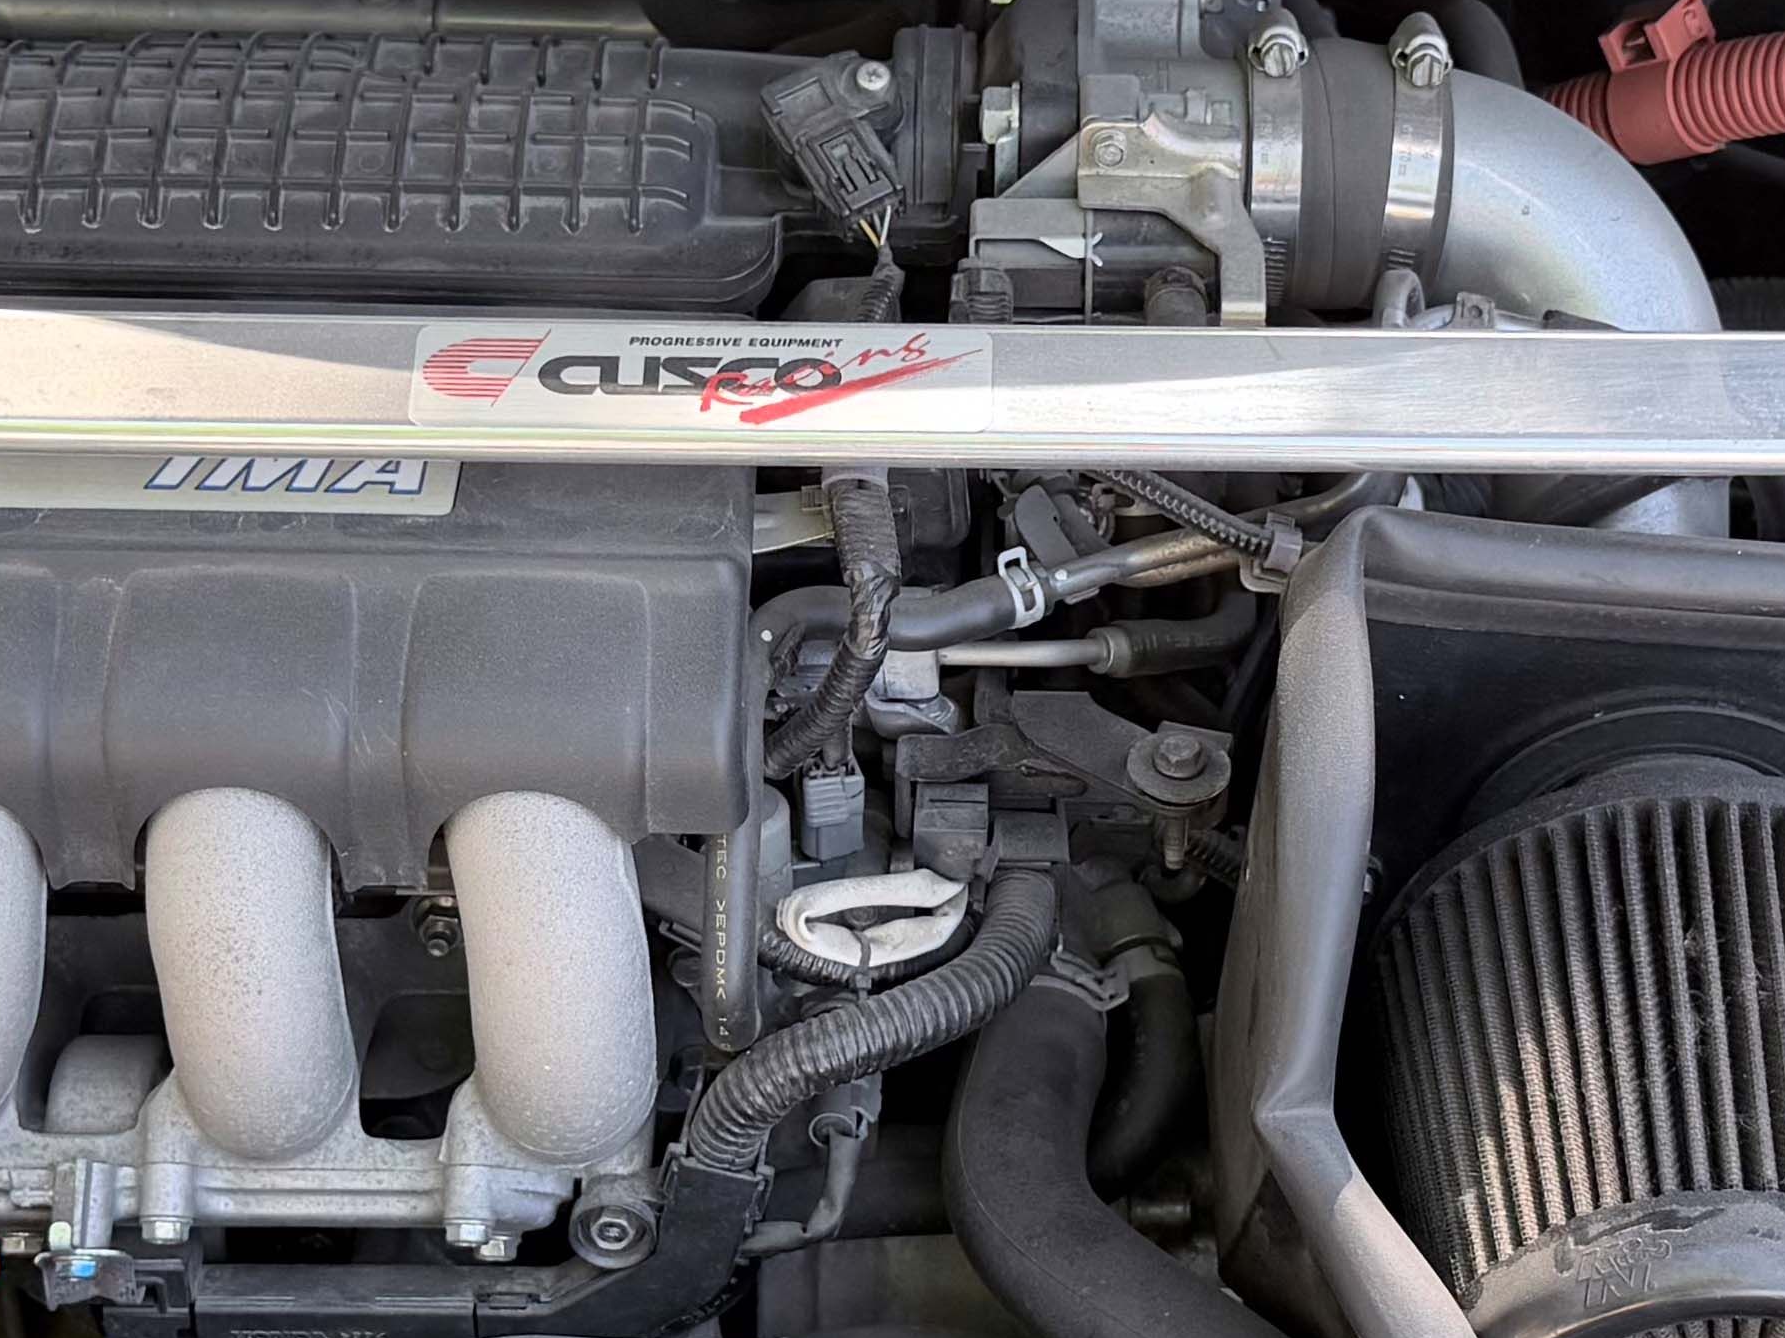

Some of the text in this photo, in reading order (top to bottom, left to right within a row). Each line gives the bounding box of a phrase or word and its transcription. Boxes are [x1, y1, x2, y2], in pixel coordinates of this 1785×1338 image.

[629, 336, 844, 349] PROGRESSIVE EQUIPMENT
[538, 355, 843, 396] CUSCO
